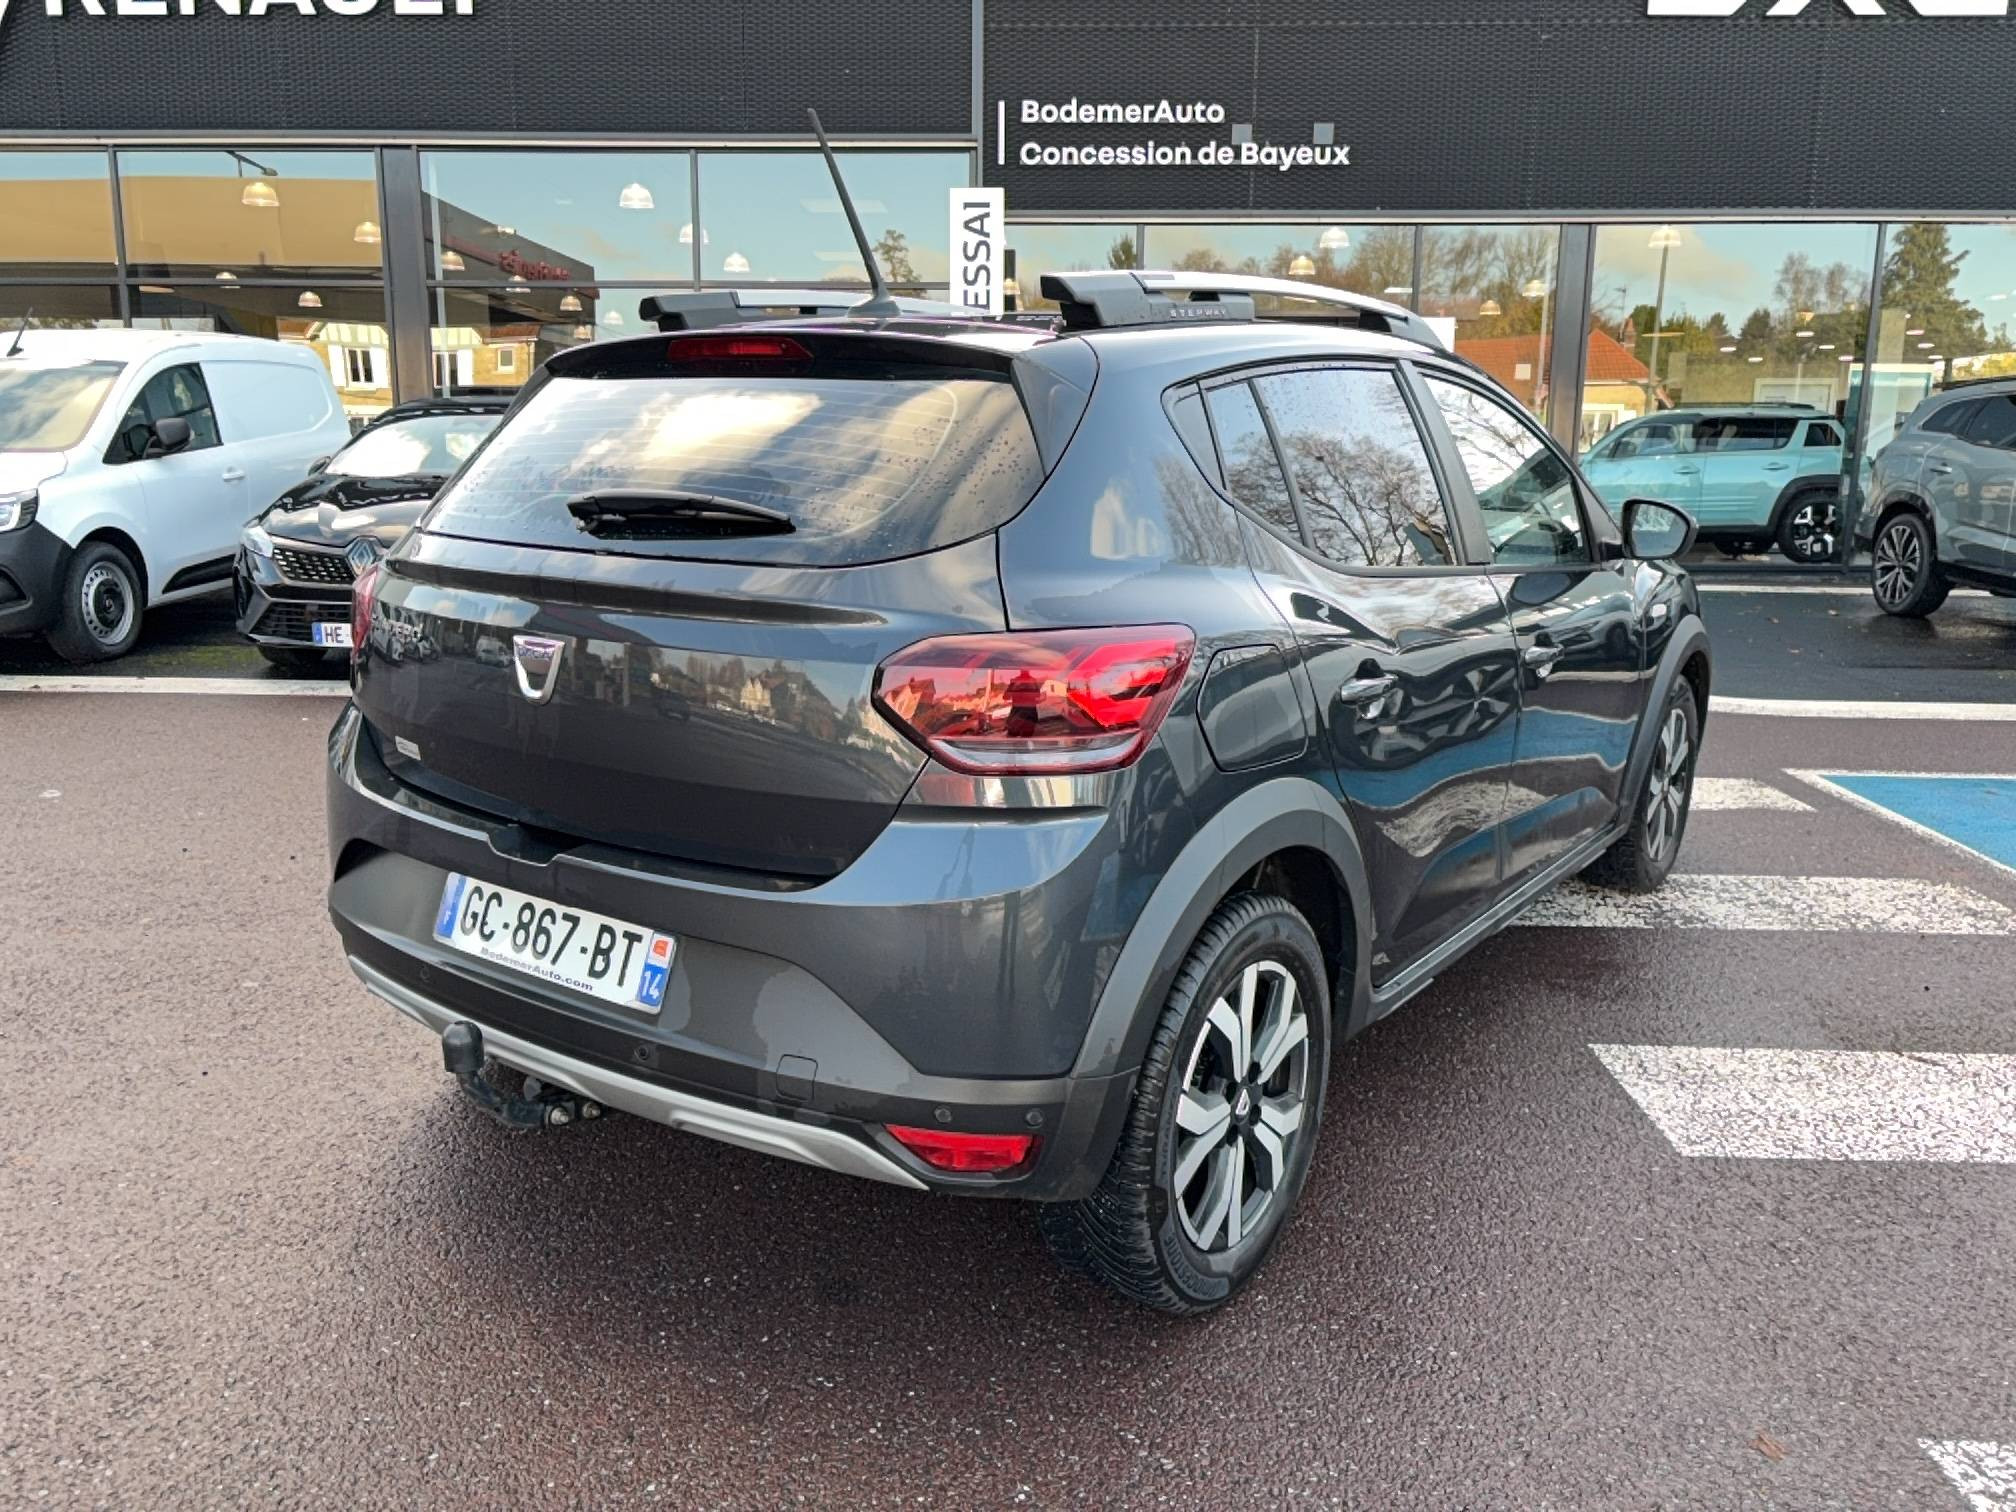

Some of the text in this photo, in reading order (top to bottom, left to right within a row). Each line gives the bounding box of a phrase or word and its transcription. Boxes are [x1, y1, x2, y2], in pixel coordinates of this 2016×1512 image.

[1020, 96, 1226, 124] BodemerAuto
[1020, 141, 1351, 172] Concession de Bayeux
[962, 201, 991, 311] ESSAI
[460, 885, 644, 988] GC-867-BT
[640, 970, 662, 1000] 14
